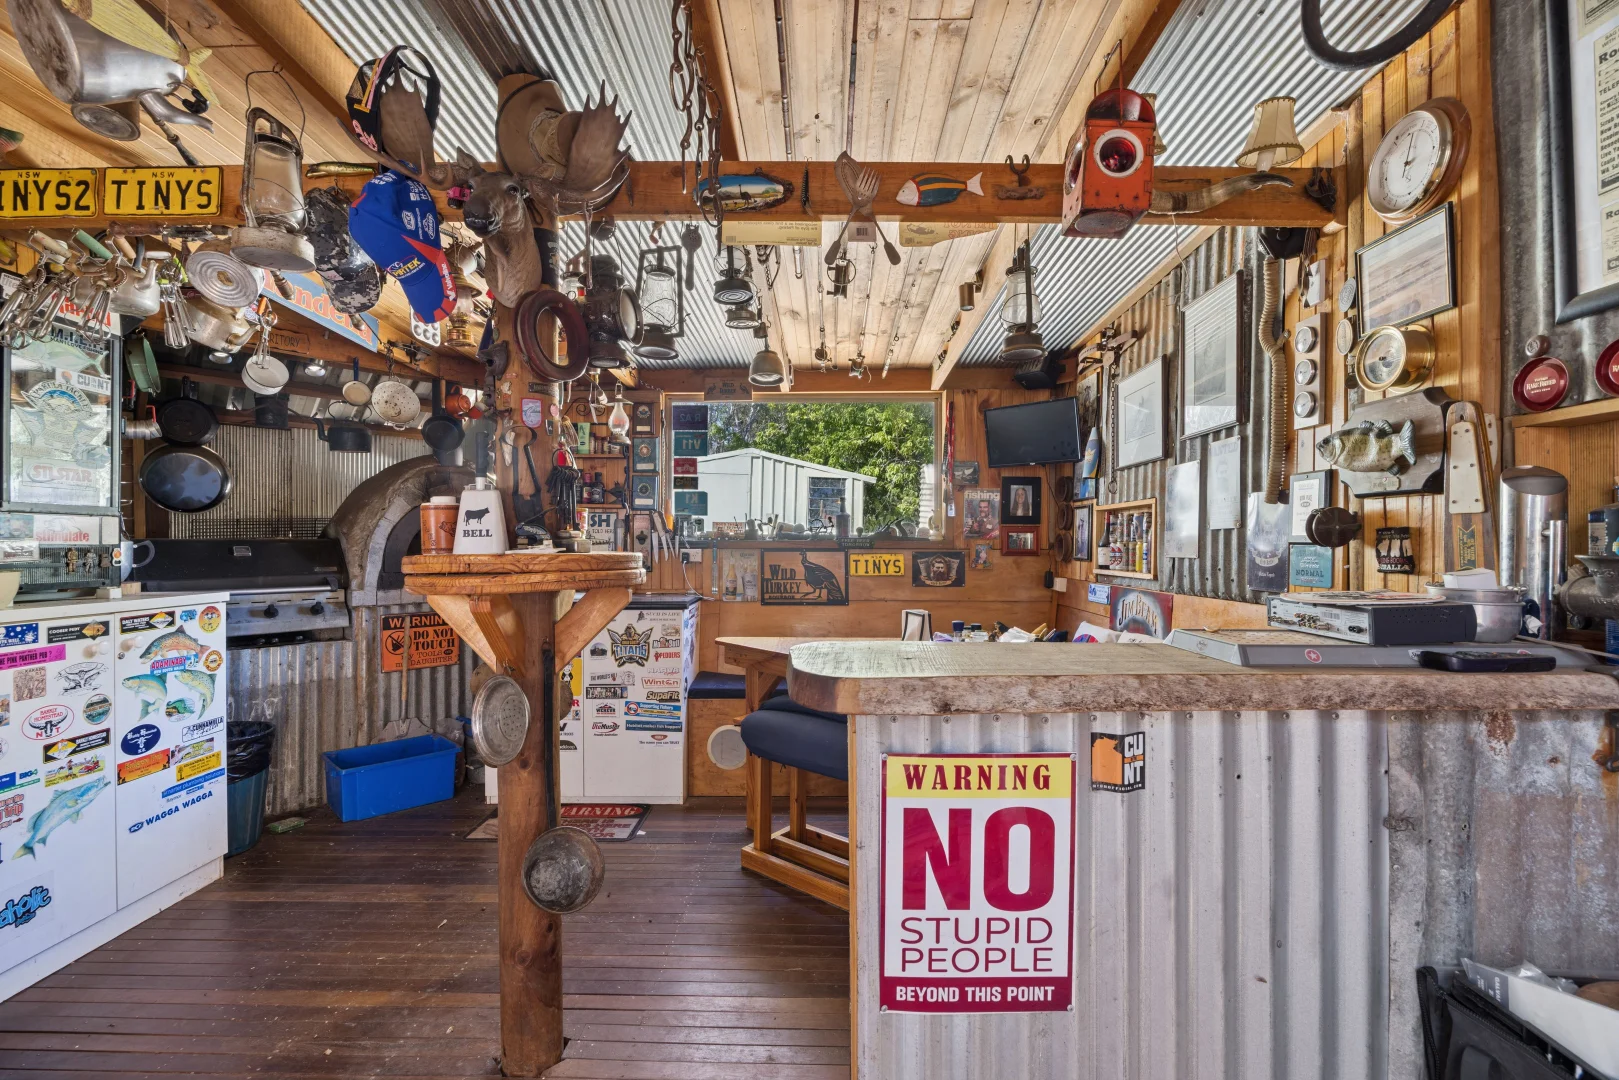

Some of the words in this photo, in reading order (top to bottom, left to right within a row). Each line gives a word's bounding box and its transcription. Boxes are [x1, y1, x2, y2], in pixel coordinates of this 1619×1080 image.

[111, 179, 213, 210] TINYS
[964, 490, 1000, 501] fishing
[590, 514, 611, 528] SH
[36, 531, 90, 542] stimulate
[462, 529, 492, 538] BELL
[768, 564, 796, 580] WILD
[852, 560, 902, 574] TINYS
[1296, 568, 1324, 578] NORMAL
[764, 578, 802, 594] TURKEY
[1118, 598, 1135, 626] JIM
[1136, 594, 1158, 636] BEAM
[388, 616, 443, 629] WRNIN
[413, 630, 430, 640] DO
[432, 628, 454, 639] NOT
[413, 638, 455, 651] TOUCH
[614, 644, 647, 657] TITANS
[19, 652, 38, 662] PANTHER
[40, 651, 48, 660] PUB
[410, 656, 453, 666] DAUGHTER
[417, 650, 442, 658] TOOLS
[151, 657, 186, 670] ADAMINABY
[34, 712, 64, 723] HOMESTEAD
[1124, 734, 1144, 758] CU
[902, 764, 1052, 791] WARNING
[1124, 760, 1144, 784] NT
[146, 806, 180, 826] WAGGA
[182, 790, 213, 809] WAGGA
[902, 806, 1056, 912] NO
[900, 917, 1053, 944] STUPID
[901, 948, 1053, 972] PEOPLE
[896, 986, 960, 1002] BEYOND
[965, 986, 1002, 1002] THIS
[1007, 986, 1055, 1002] POINT
